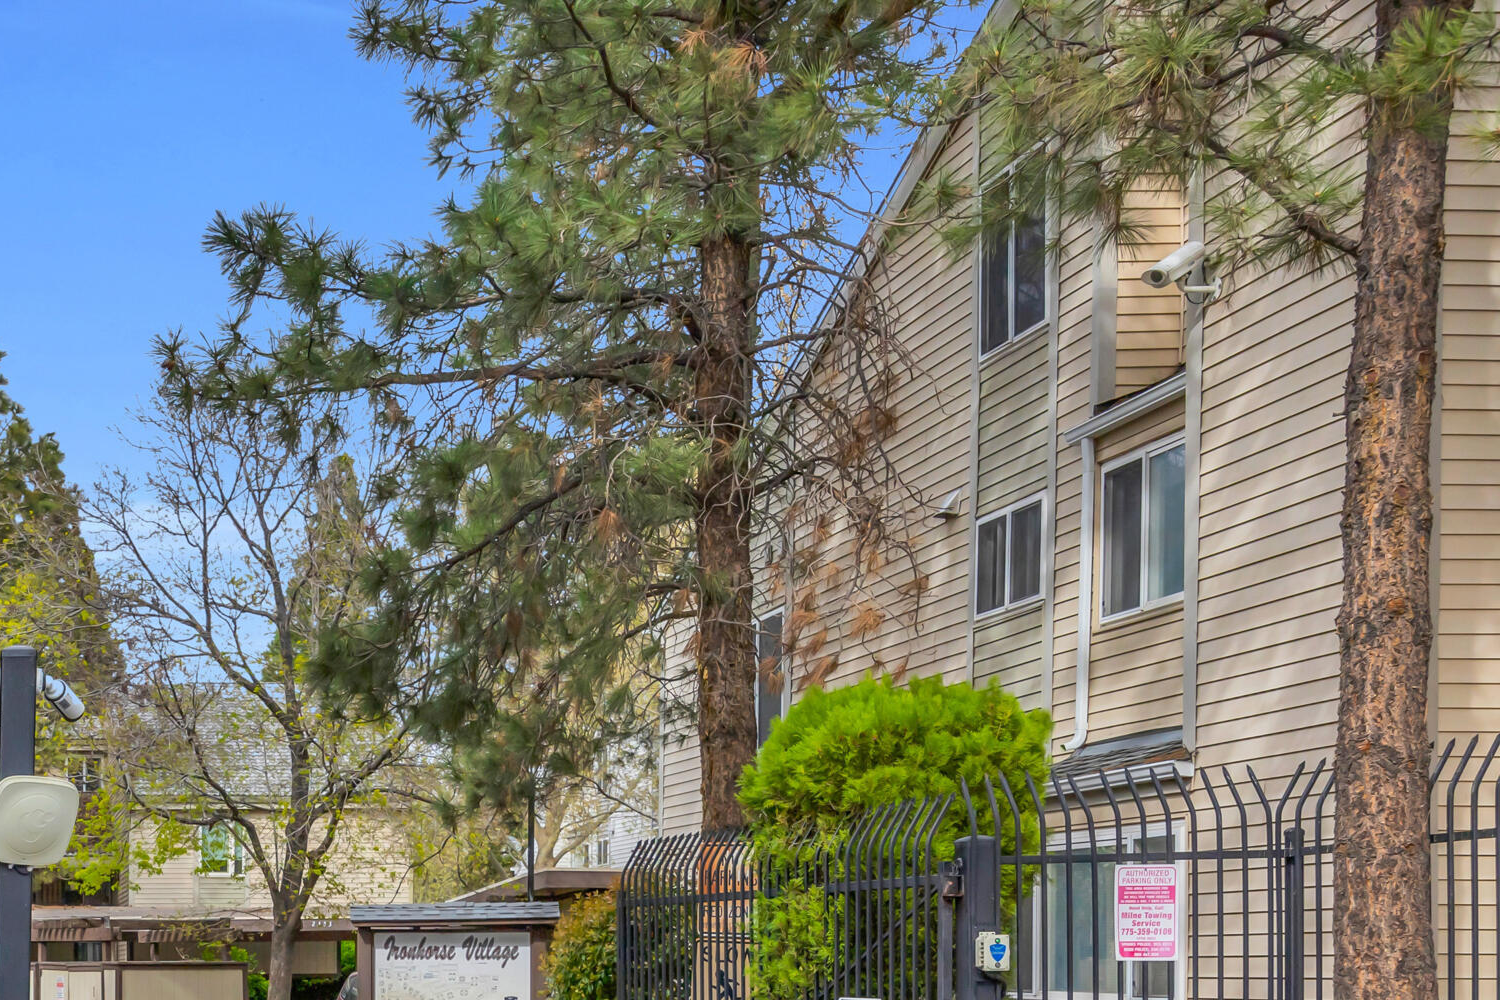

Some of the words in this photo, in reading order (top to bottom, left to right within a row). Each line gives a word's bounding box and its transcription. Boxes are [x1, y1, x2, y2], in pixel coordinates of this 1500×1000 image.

[1121, 877, 1152, 885] PARKING
[1153, 877, 1173, 885] ONLY
[1144, 912, 1173, 920] Towing
[384, 935, 456, 961] Ironhorse
[462, 935, 520, 968] Village
